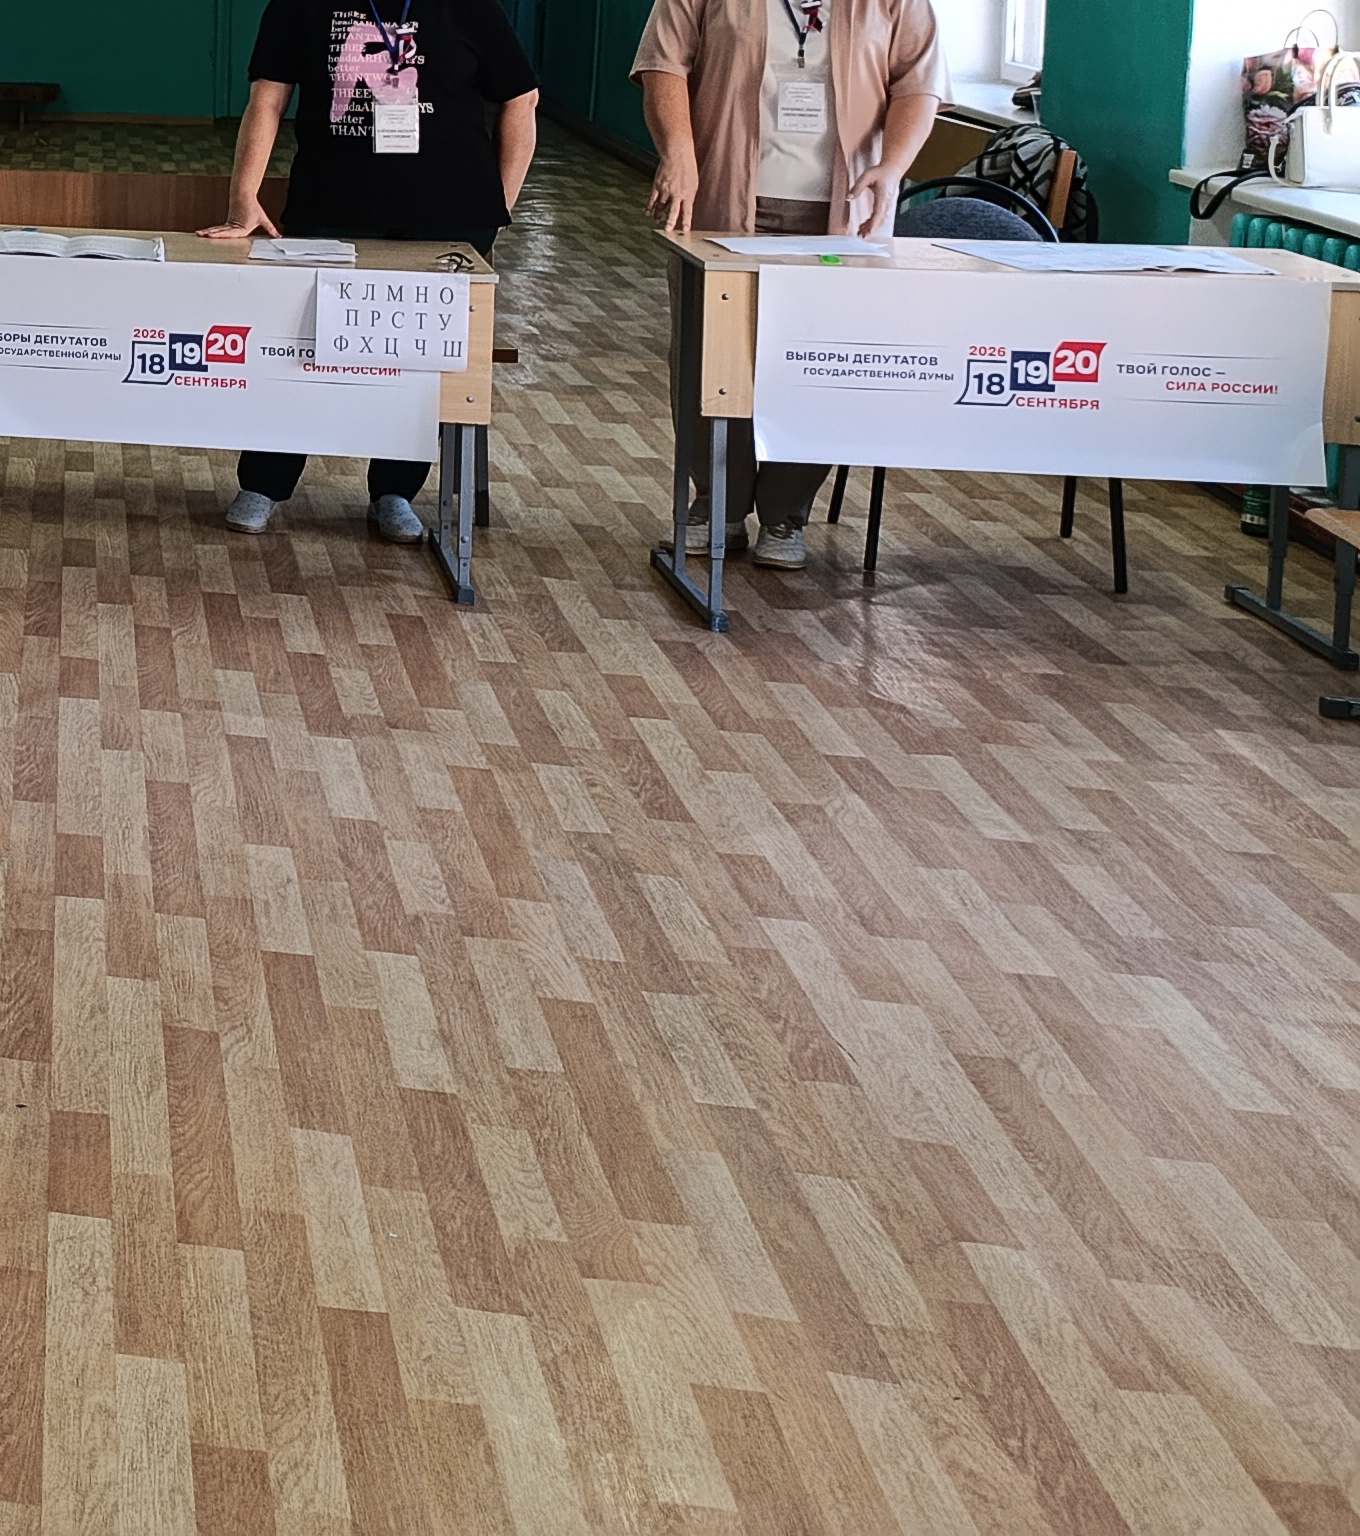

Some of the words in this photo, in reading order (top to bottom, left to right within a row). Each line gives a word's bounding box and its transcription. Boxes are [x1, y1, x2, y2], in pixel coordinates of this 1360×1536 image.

[330, 33, 385, 41] THANTW
[329, 44, 367, 53] THREE
[328, 64, 360, 73] better
[331, 88, 372, 99] THREE
[330, 115, 364, 124] better
[339, 282, 353, 300] К
[362, 283, 375, 301] Л
[387, 284, 404, 302] М
[415, 286, 428, 303] Н
[440, 287, 454, 305] О
[345, 309, 359, 326] П
[370, 310, 381, 327] Р
[392, 311, 405, 329] С
[415, 312, 428, 330] Т
[438, 314, 452, 331] У
[33, 334, 108, 347] ДЕПУТАТОВ
[133, 329, 166, 339] 2026
[137, 353, 165, 374] 18
[171, 342, 201, 364] 19
[207, 332, 244, 356] 20
[260, 345, 295, 358] ТВОЙ
[333, 335, 349, 352] Ф
[359, 336, 374, 353] Х
[385, 337, 399, 358] Ц
[414, 339, 427, 356] Ч
[443, 341, 462, 358] Ш
[969, 345, 1006, 357] 2026
[91, 353, 122, 361] ДУМЫ
[785, 350, 849, 363] ВЫБОРЫ
[852, 353, 938, 367] ДЕПУТАТОВ
[803, 368, 916, 380] ГОСУДАРСТВЕННОЙ
[918, 371, 954, 382] ДУМЫ
[972, 373, 1005, 395] 18
[1013, 360, 1047, 384] 19
[1054, 349, 1098, 375] 20
[1116, 363, 1157, 375] ТВОЙ
[1161, 365, 1212, 377] ГОЛОС
[174, 375, 247, 389] СЕНТЯБРЯ
[1165, 381, 1207, 392] СИЛА
[1211, 383, 1278, 395] РОССИИ!
[1015, 396, 1100, 410] СЕНТЯБРЯ
